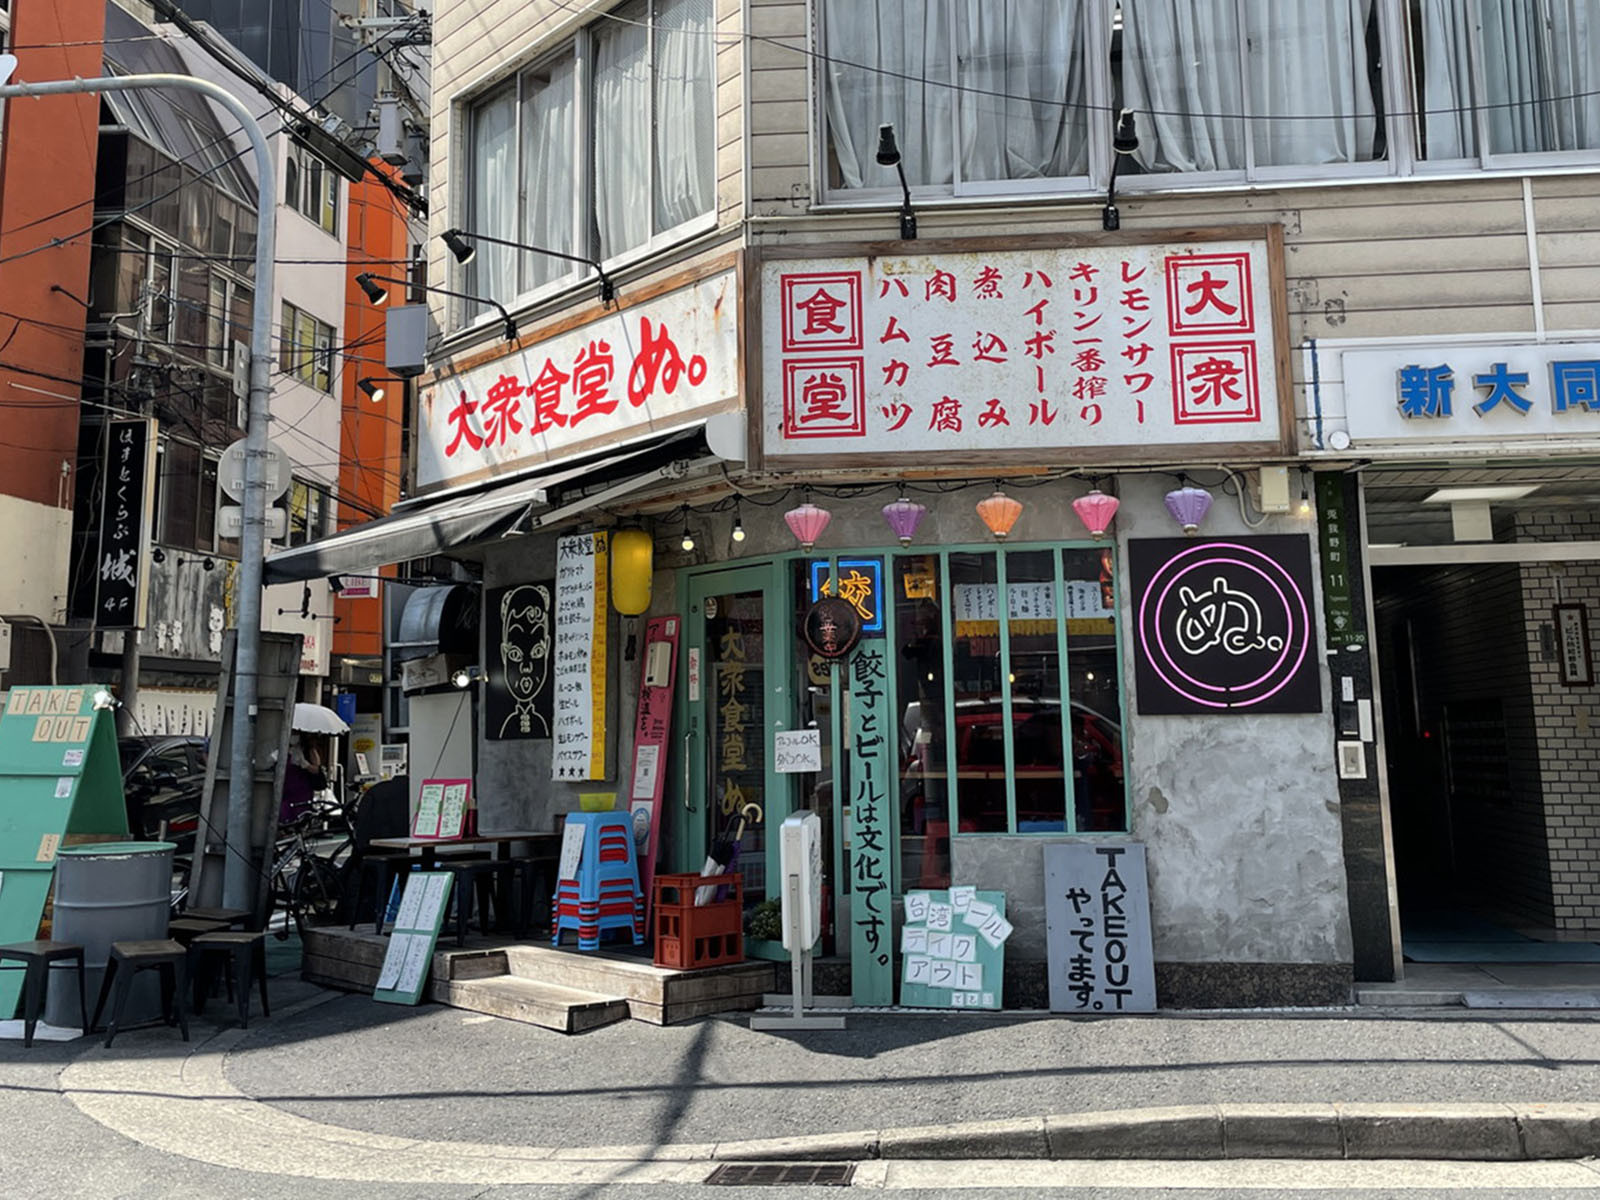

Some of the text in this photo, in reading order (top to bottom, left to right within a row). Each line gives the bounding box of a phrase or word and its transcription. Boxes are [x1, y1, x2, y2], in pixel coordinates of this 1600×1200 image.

[879, 278, 914, 432] ハムカツ
[925, 269, 964, 433] 肉豆腐
[972, 265, 1010, 428] 煮込み
[1022, 269, 1058, 427] ハイボール
[1068, 261, 1107, 426] キリン一番搾り
[1120, 260, 1154, 425] レモンサワー
[101, 428, 137, 612] ほすとくらぶ 城 4F
[1330, 574, 1344, 586] 11
[13, 690, 81, 713] TAKE
[38, 719, 89, 740] OUT
[851, 649, 889, 966] 餃子とビールは文化です。
[906, 931, 970, 958] テイク
[909, 890, 1001, 939] 台湾 ビール
[911, 960, 975, 985] アウト
[1066, 887, 1103, 1010] やってます。
[1096, 847, 1133, 1010] TAKEOUT
